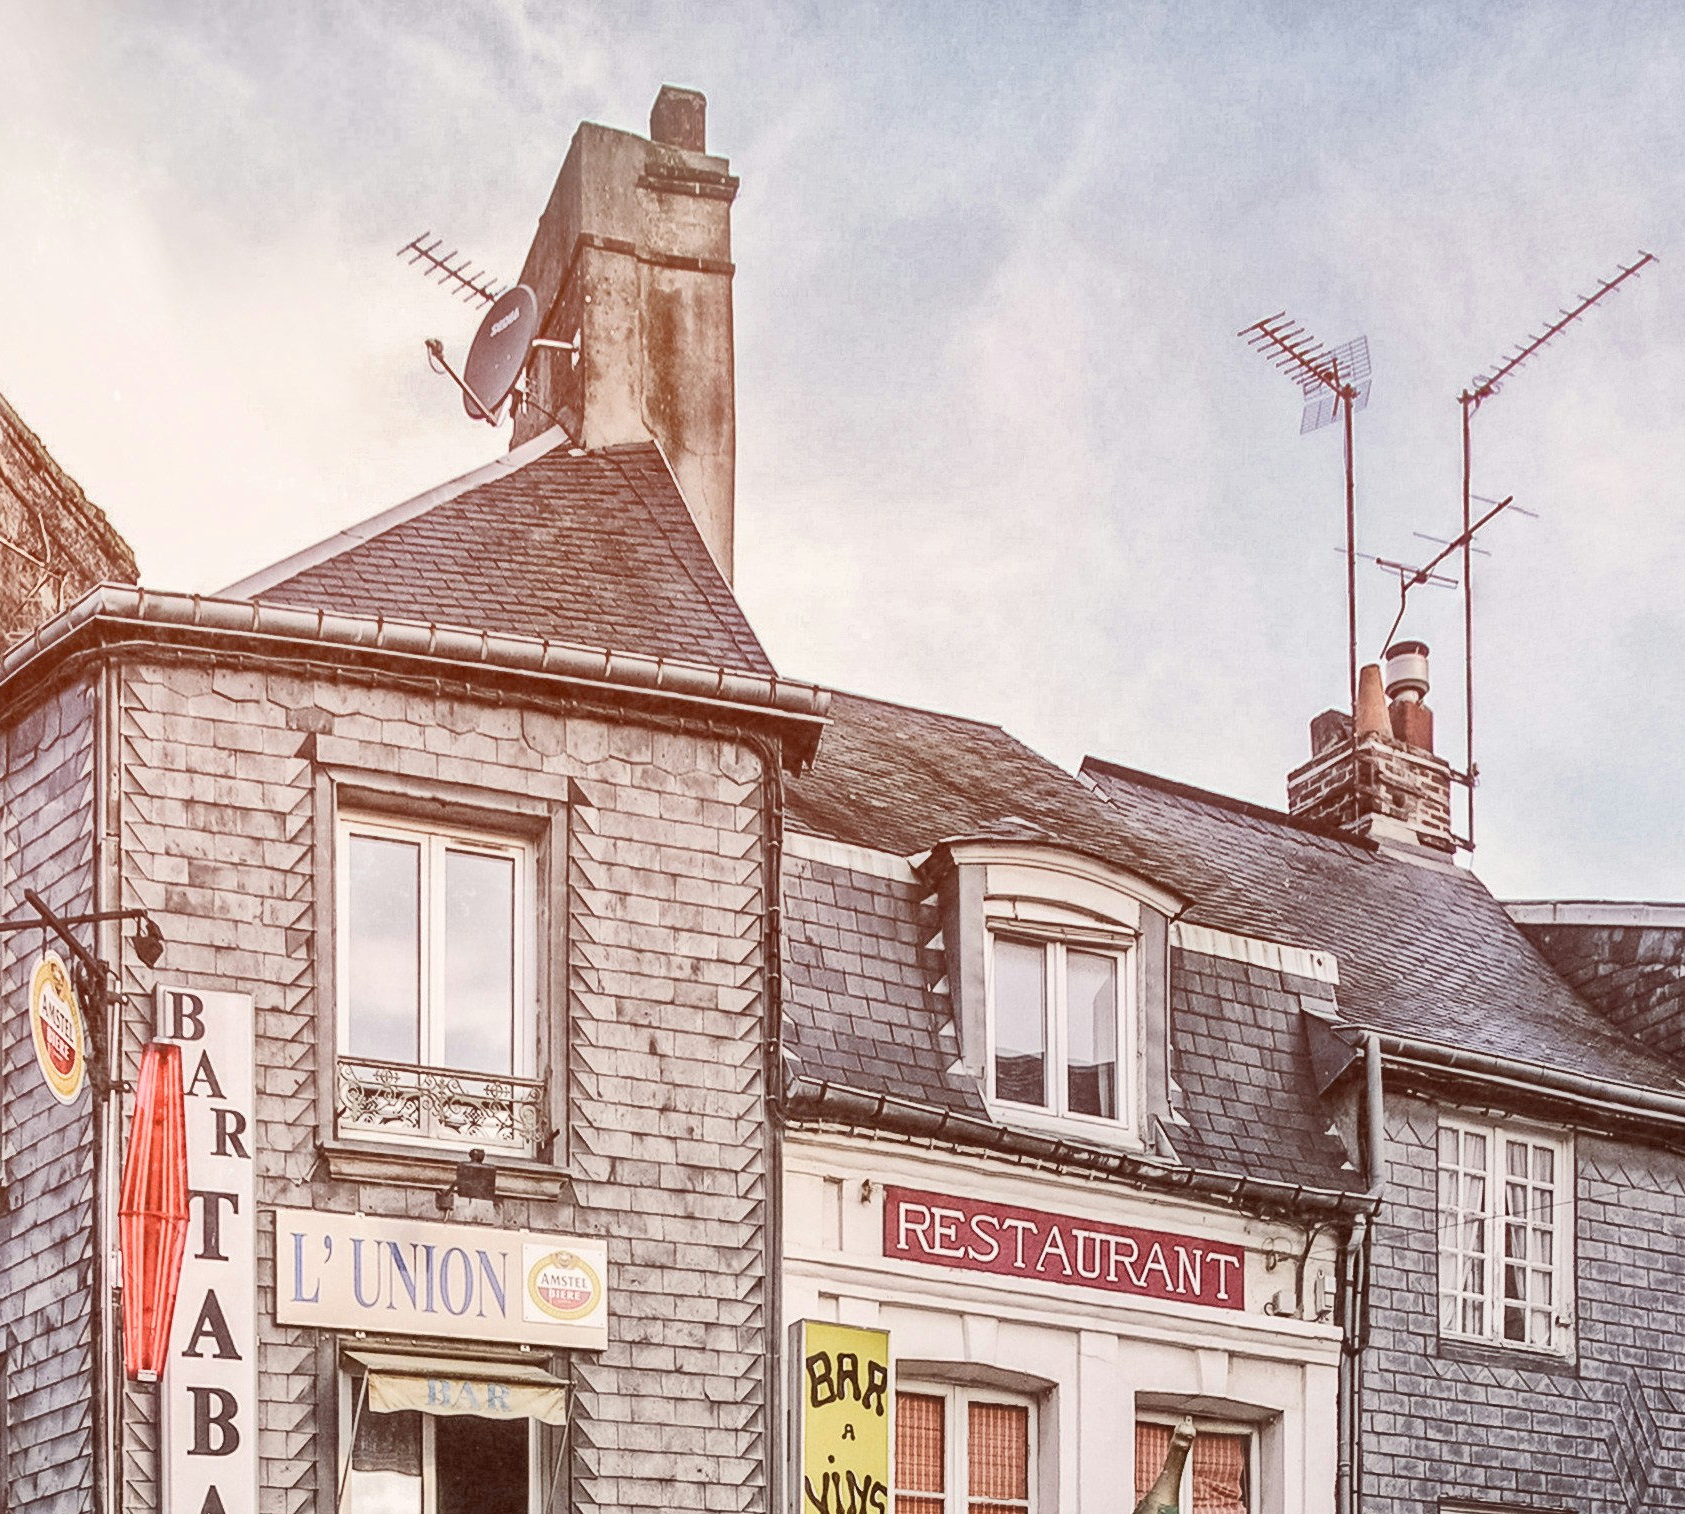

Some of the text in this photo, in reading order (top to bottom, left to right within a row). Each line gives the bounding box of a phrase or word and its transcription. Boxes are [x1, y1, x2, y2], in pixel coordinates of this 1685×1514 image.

[41, 993, 74, 1044] AMSTEL
[896, 1201, 1240, 1300] RESTAURANT
[540, 1272, 588, 1289] AMSTEL
[427, 1378, 514, 1413] BAR
[805, 1350, 888, 1417] BAR
[841, 1423, 856, 1441] A
